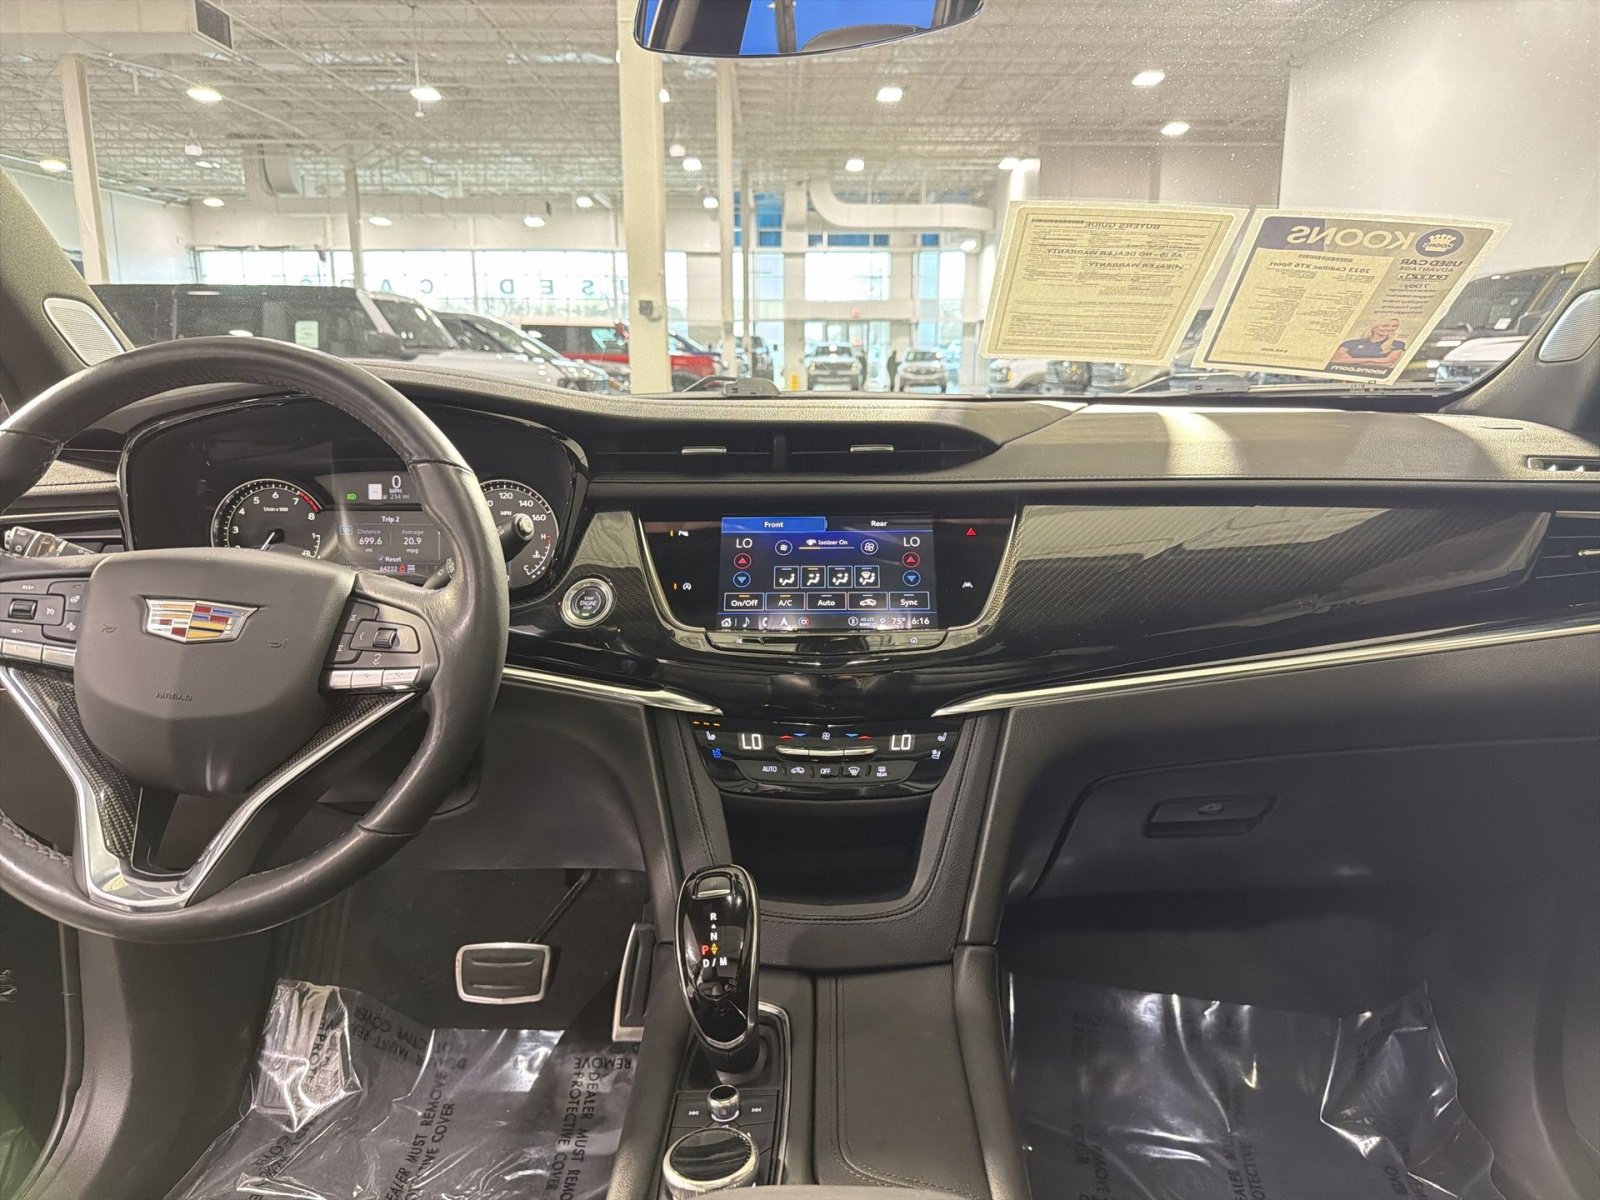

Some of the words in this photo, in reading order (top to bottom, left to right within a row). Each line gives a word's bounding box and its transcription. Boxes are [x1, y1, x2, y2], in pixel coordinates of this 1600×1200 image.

[391, 475, 401, 488] 0
[253, 496, 260, 504] 5
[499, 492, 514, 500] 120
[293, 497, 299, 506] 7
[518, 500, 534, 508] 140
[238, 508, 246, 516] 4
[308, 512, 316, 520] 8
[381, 516, 394, 524] Trip
[763, 520, 784, 528] Front
[232, 526, 239, 534] 3
[359, 538, 383, 546] 699.6
[403, 537, 422, 546] 20.9
[736, 538, 753, 548] LO
[818, 538, 838, 546] Ionizer
[838, 538, 848, 546] On
[903, 536, 920, 547] LO
[730, 598, 758, 608] On/Off
[778, 599, 792, 607] A/C
[900, 598, 918, 607] Sync
[892, 616, 906, 625] 75°
[912, 617, 930, 625] 6:16
[156, 692, 192, 702] AIRBAG
[742, 733, 762, 750] LO
[891, 734, 912, 750] LO
[710, 912, 717, 921] R
[710, 932, 718, 940] N
[702, 945, 709, 955] P
[574, 1056, 632, 1070] REMOVE
[581, 1072, 599, 1120] DEALER
[408, 1132, 428, 1164] MUST
[421, 1068, 447, 1126] REMOVE
[432, 1102, 456, 1143] COVER
[572, 1128, 588, 1162] MUST
[546, 1152, 567, 1190] COVER
